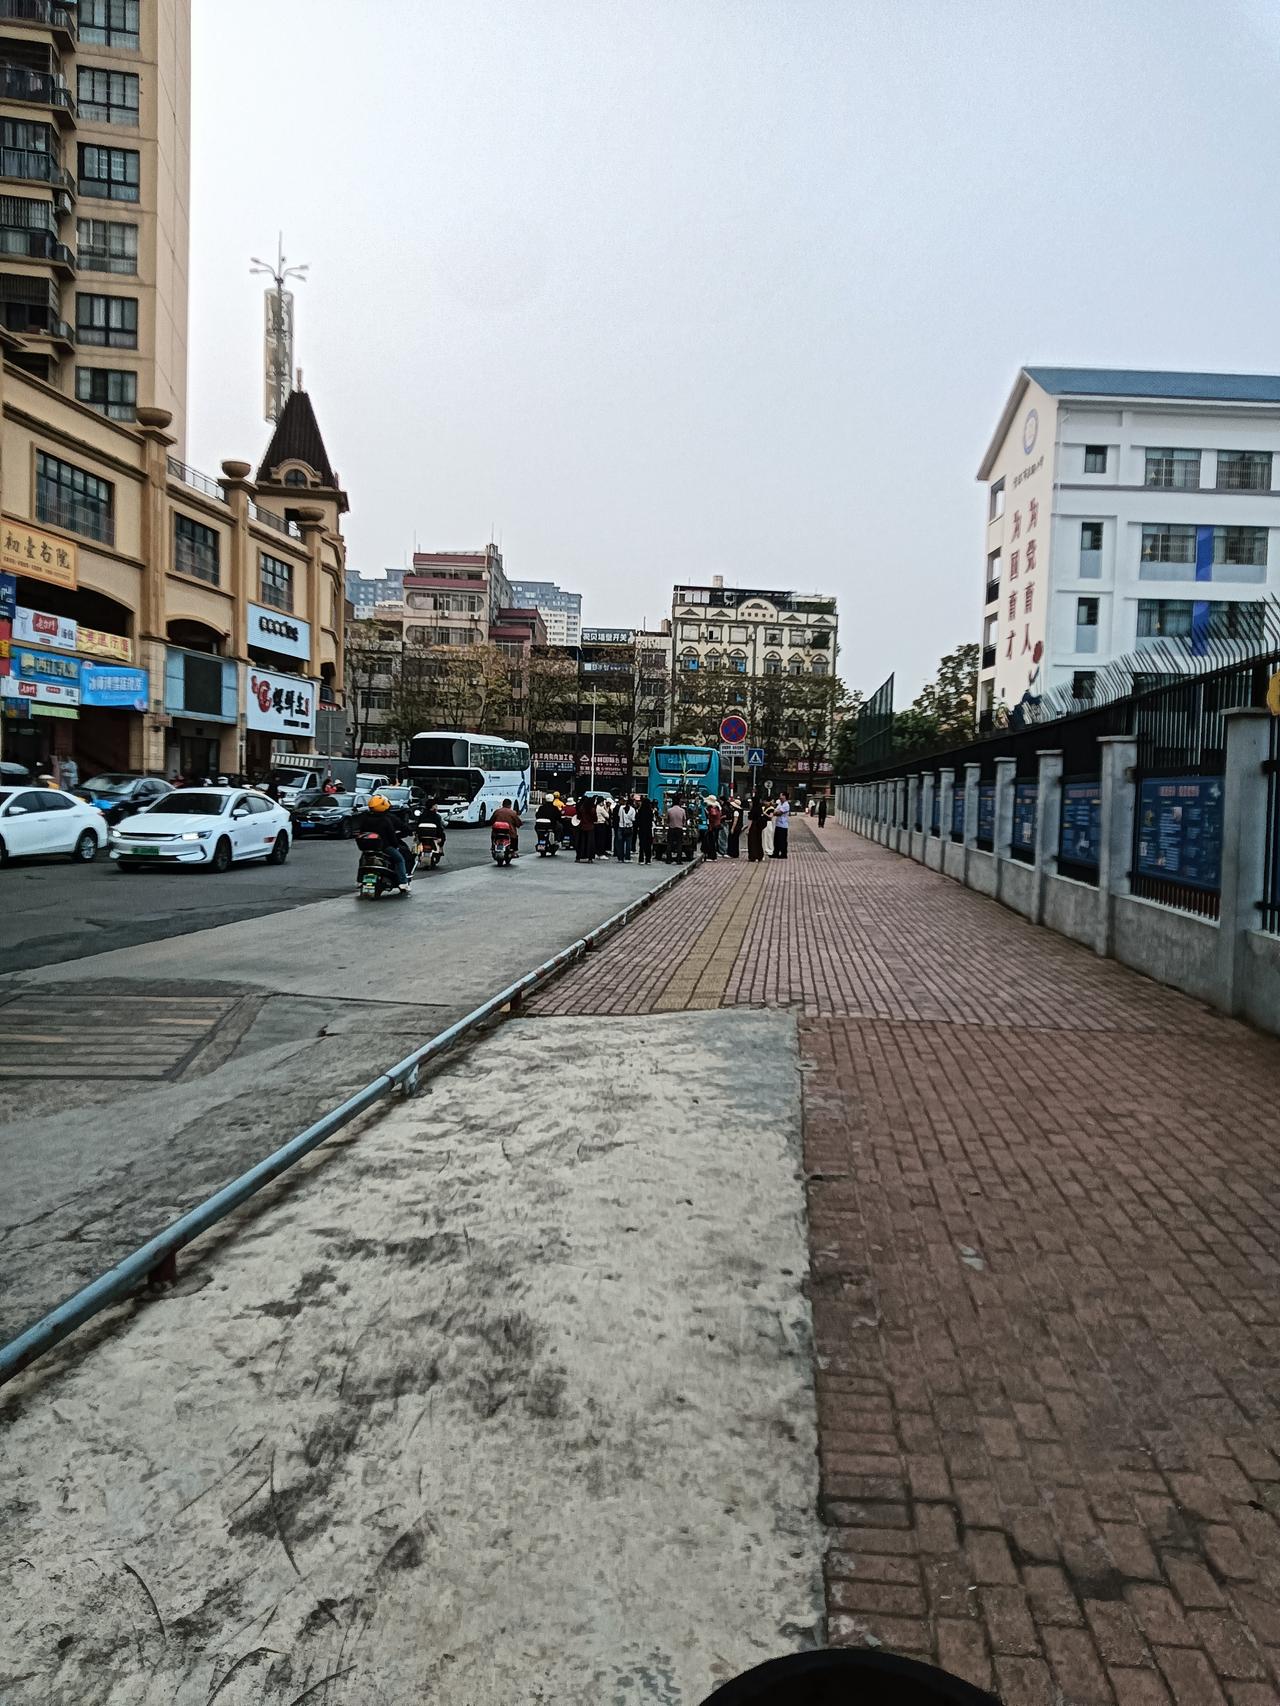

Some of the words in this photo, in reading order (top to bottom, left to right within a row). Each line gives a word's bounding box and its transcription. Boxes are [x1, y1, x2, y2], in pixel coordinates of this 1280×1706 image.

[1006, 510, 1022, 661] 为国育才
[1021, 496, 1039, 656] 为党育人
